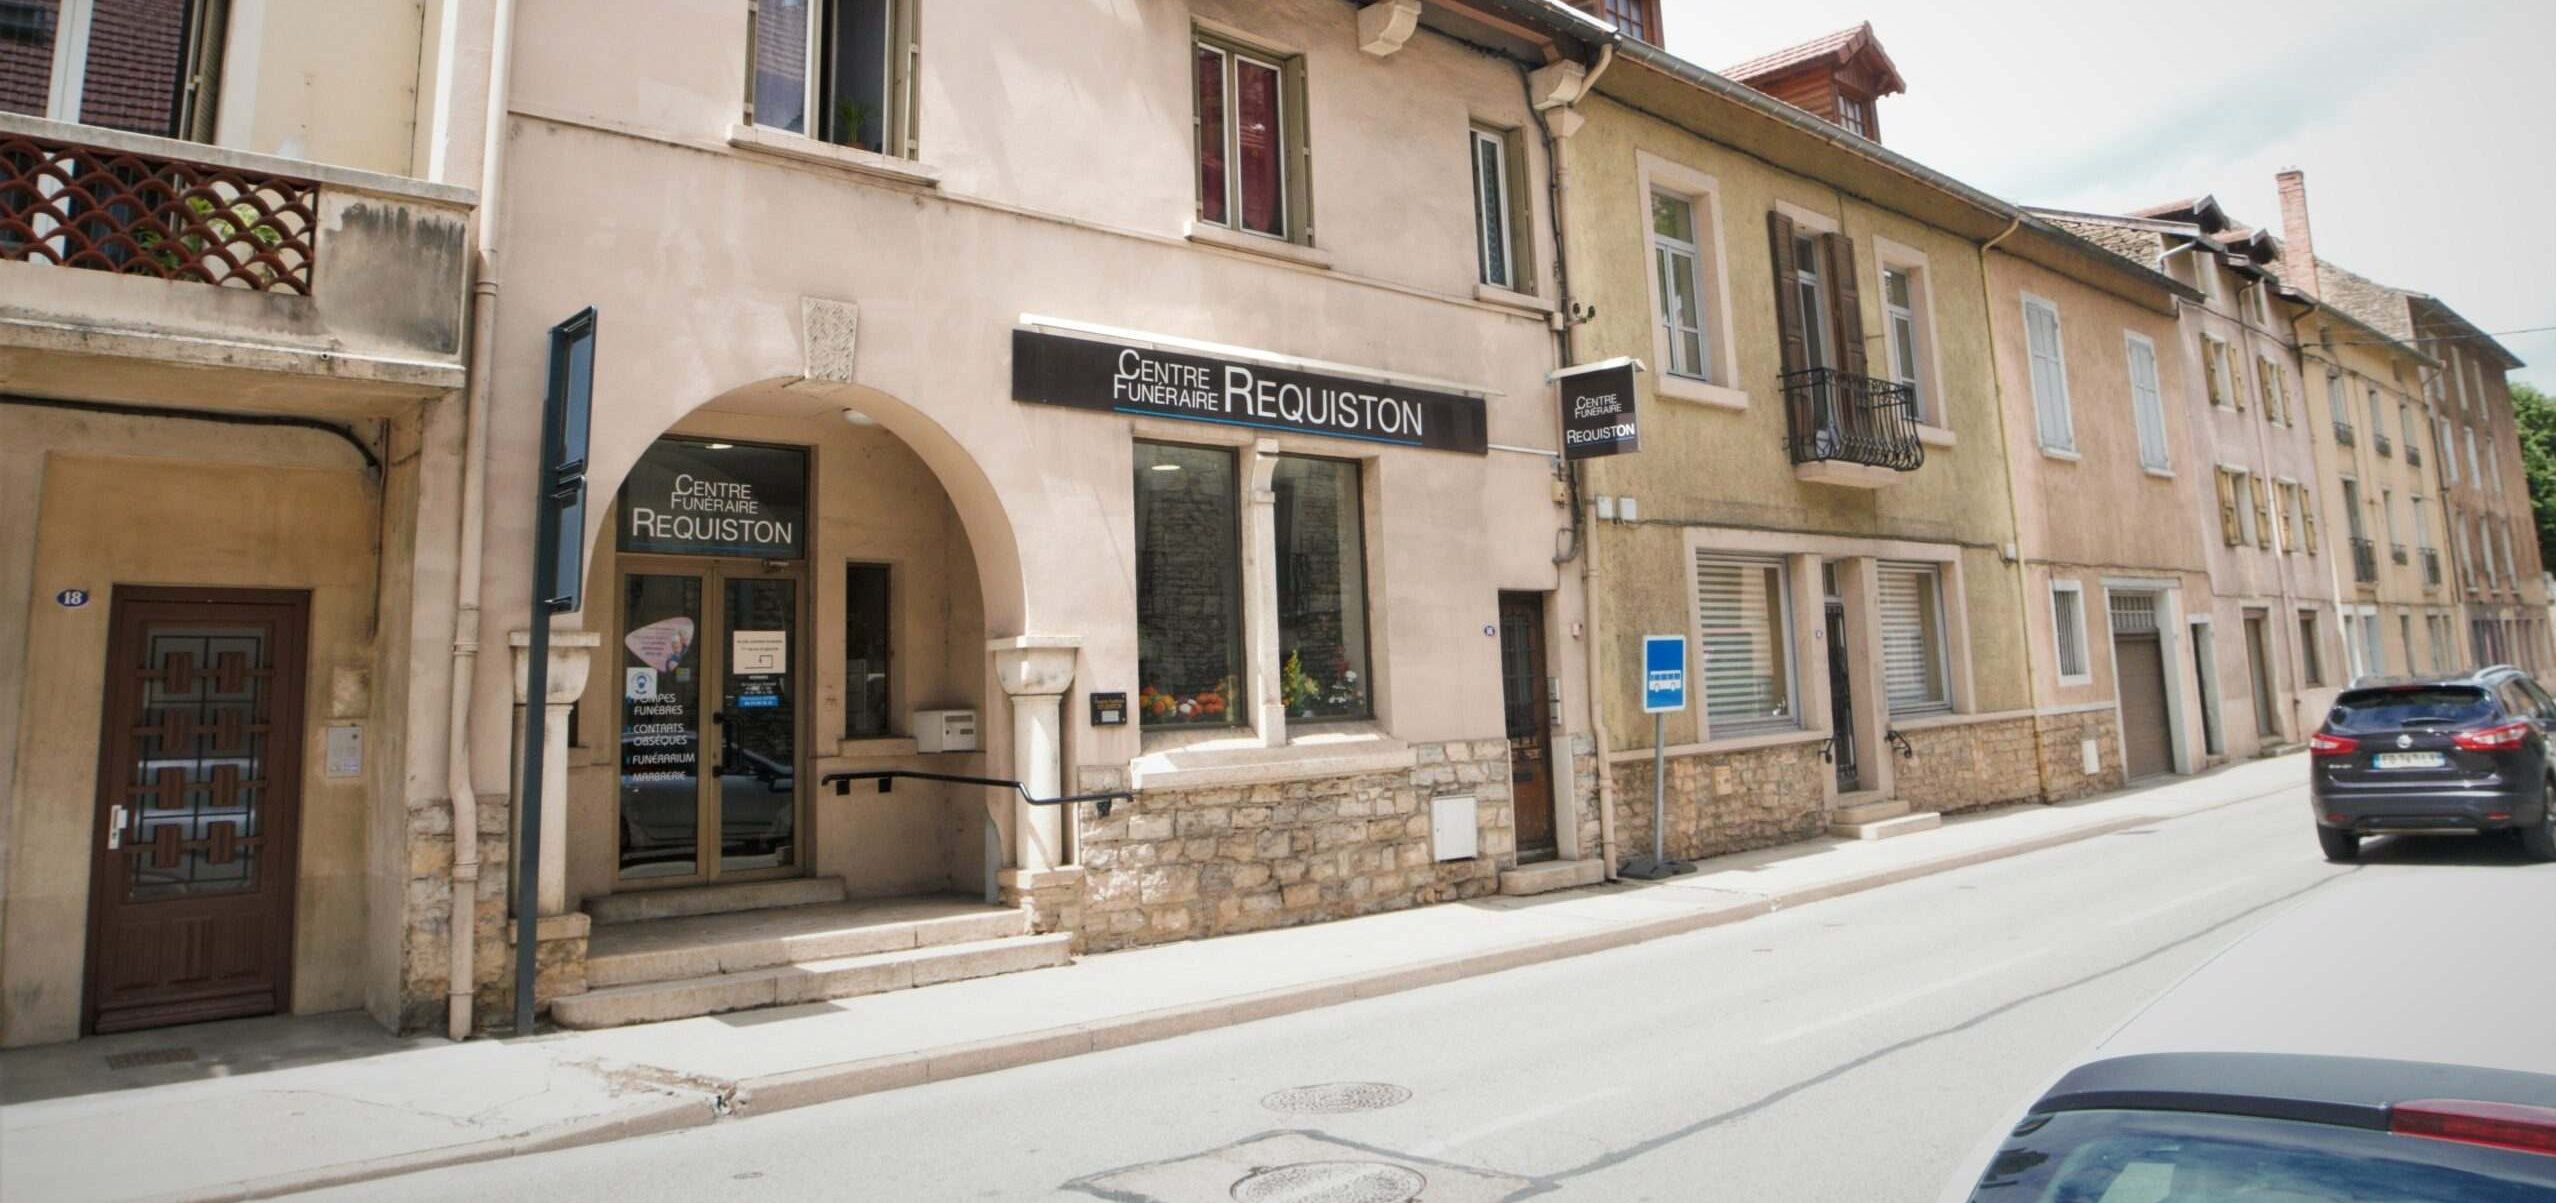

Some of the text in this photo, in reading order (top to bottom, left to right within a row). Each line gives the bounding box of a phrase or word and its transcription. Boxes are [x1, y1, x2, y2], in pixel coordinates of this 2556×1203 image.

[1118, 349, 1210, 390] CENTRE
[1113, 373, 1219, 412] FUNÉRAIRE
[1224, 365, 1423, 436] REQUISTON
[1576, 393, 1617, 409] CENTRE
[1566, 423, 1636, 444] REQUISTON
[675, 473, 753, 500] CENTRE
[670, 491, 760, 515] FUNÉRAIRE
[632, 507, 793, 544] REQUISTON
[64, 591, 82, 605] 18
[634, 693, 677, 703] OMPES
[633, 722, 685, 734] CONTRATS
[632, 752, 696, 765] FUNÉRARIUM
